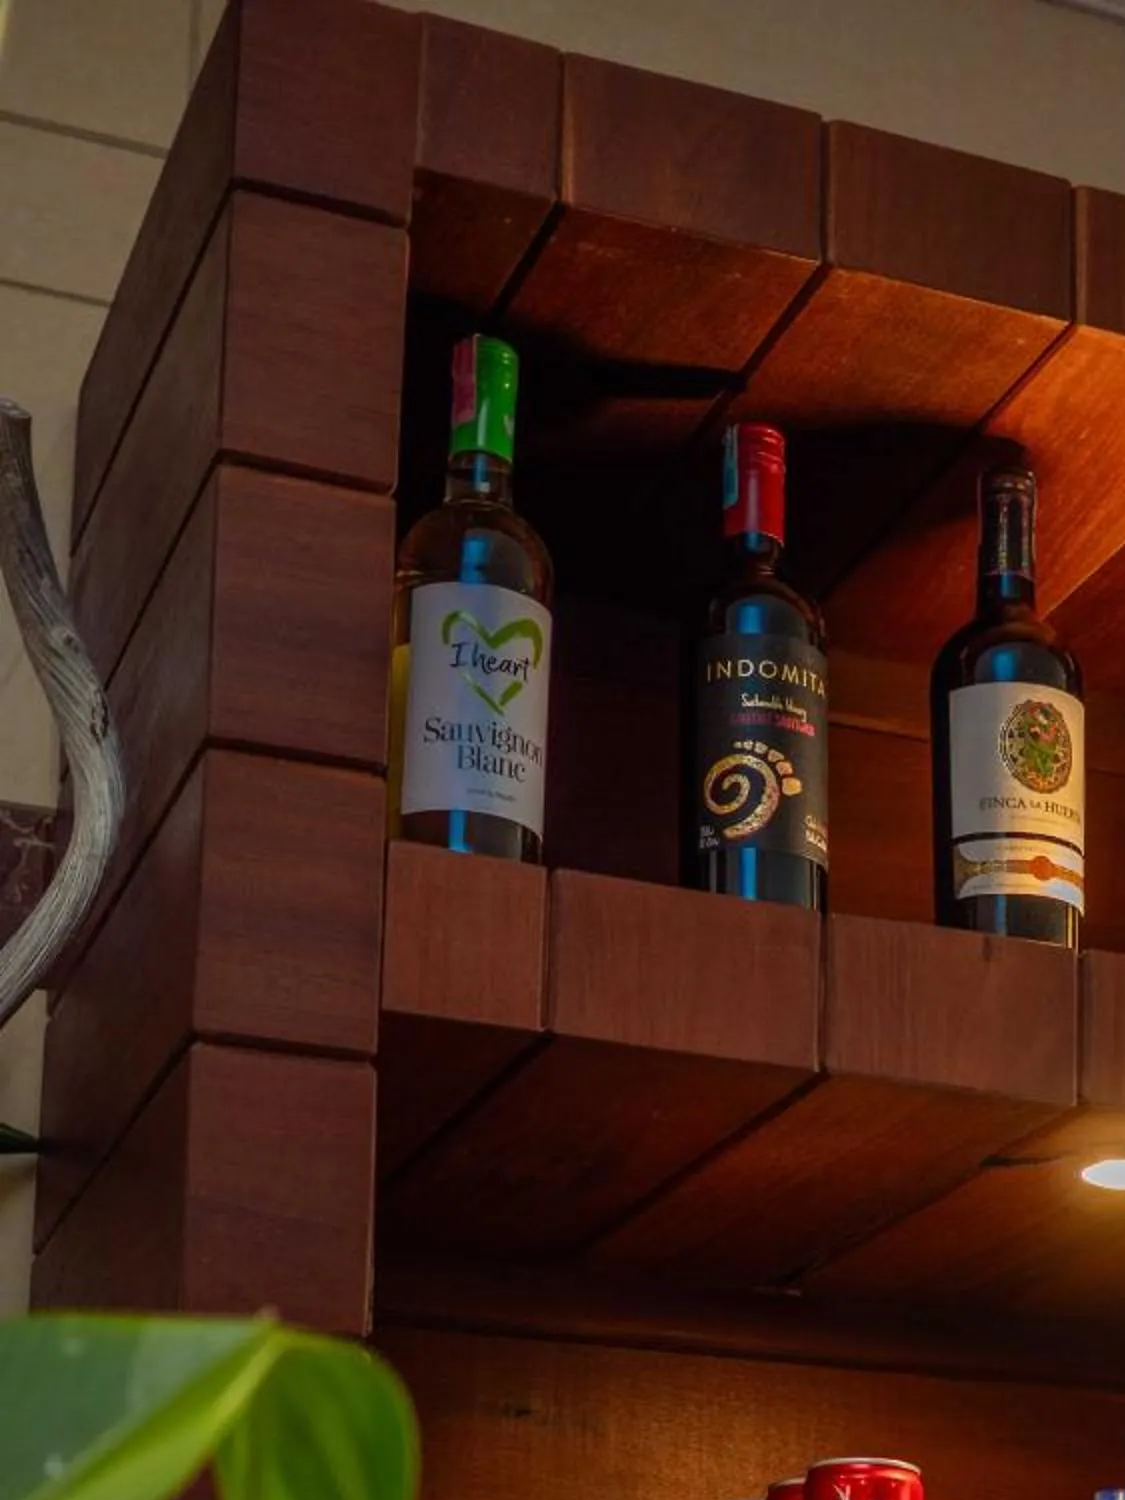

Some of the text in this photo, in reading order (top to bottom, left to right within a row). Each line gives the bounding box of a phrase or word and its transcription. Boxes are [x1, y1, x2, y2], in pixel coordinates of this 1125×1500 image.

[449, 641, 530, 682] I heart
[707, 659, 826, 698] INDOMITA
[423, 716, 543, 768] Sauvignon
[457, 745, 527, 783] Blanc
